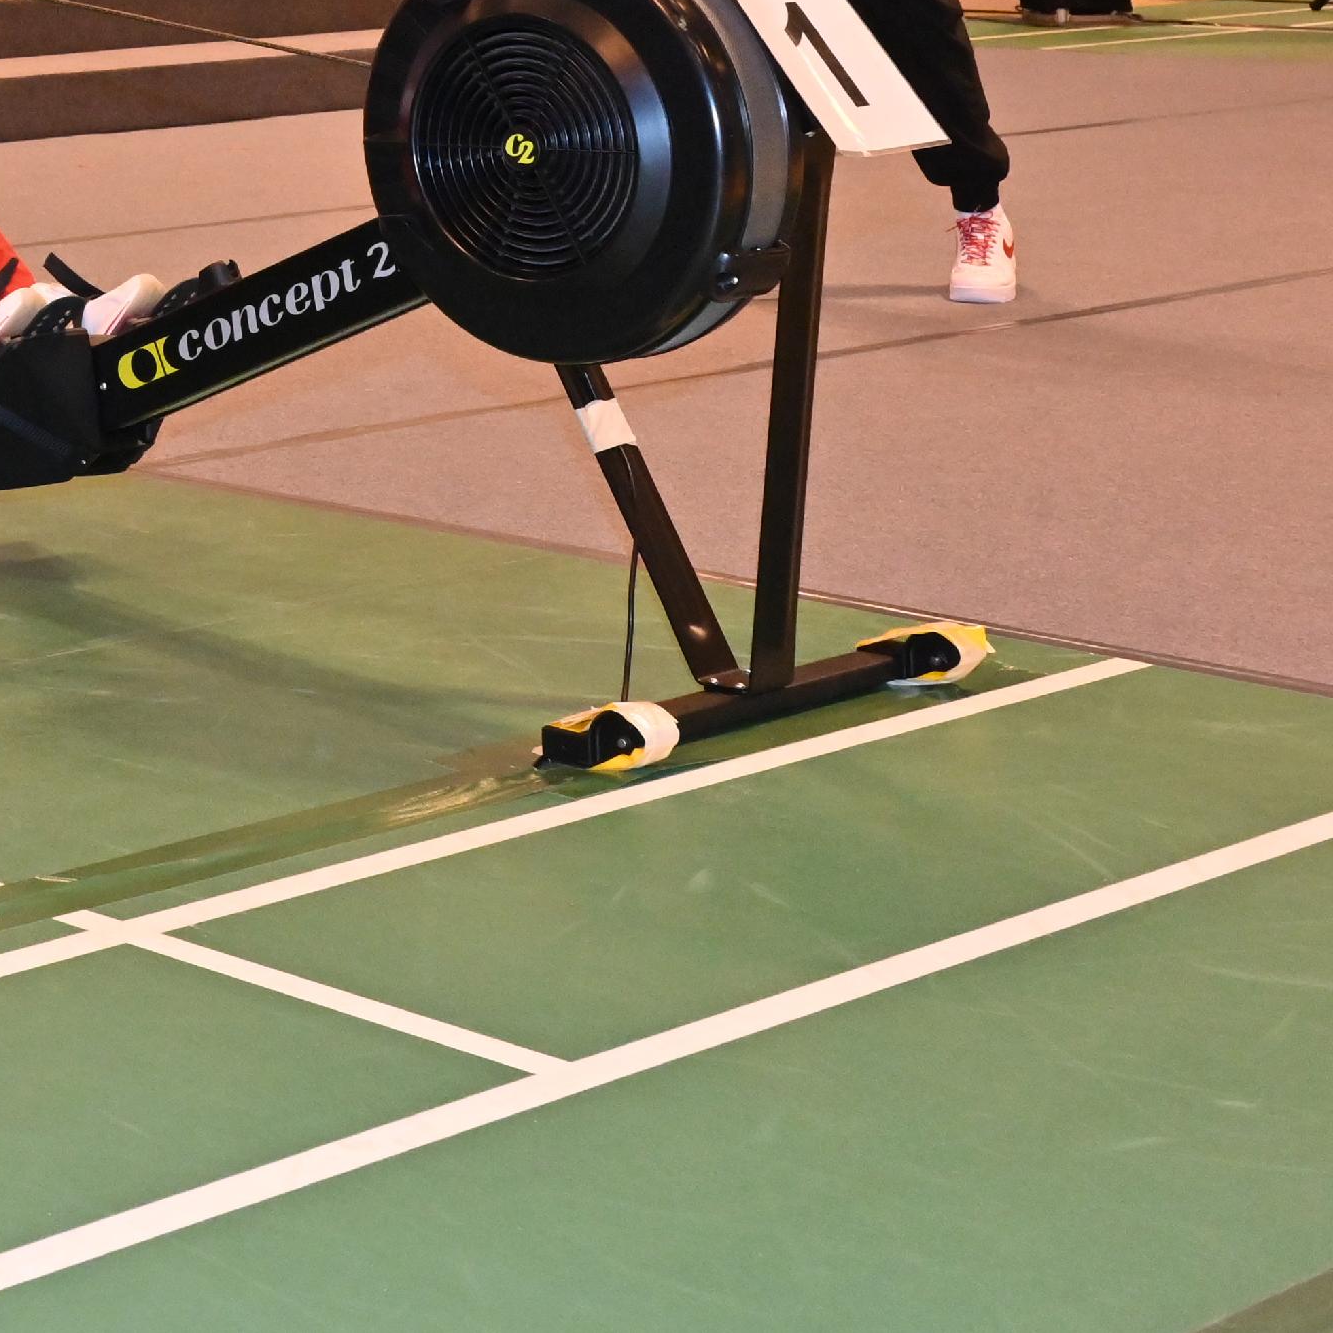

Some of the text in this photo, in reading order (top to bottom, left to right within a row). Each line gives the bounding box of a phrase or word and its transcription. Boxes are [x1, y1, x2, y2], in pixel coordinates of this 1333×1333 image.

[784, 2, 870, 108] 1
[178, 241, 397, 361] concept 2
